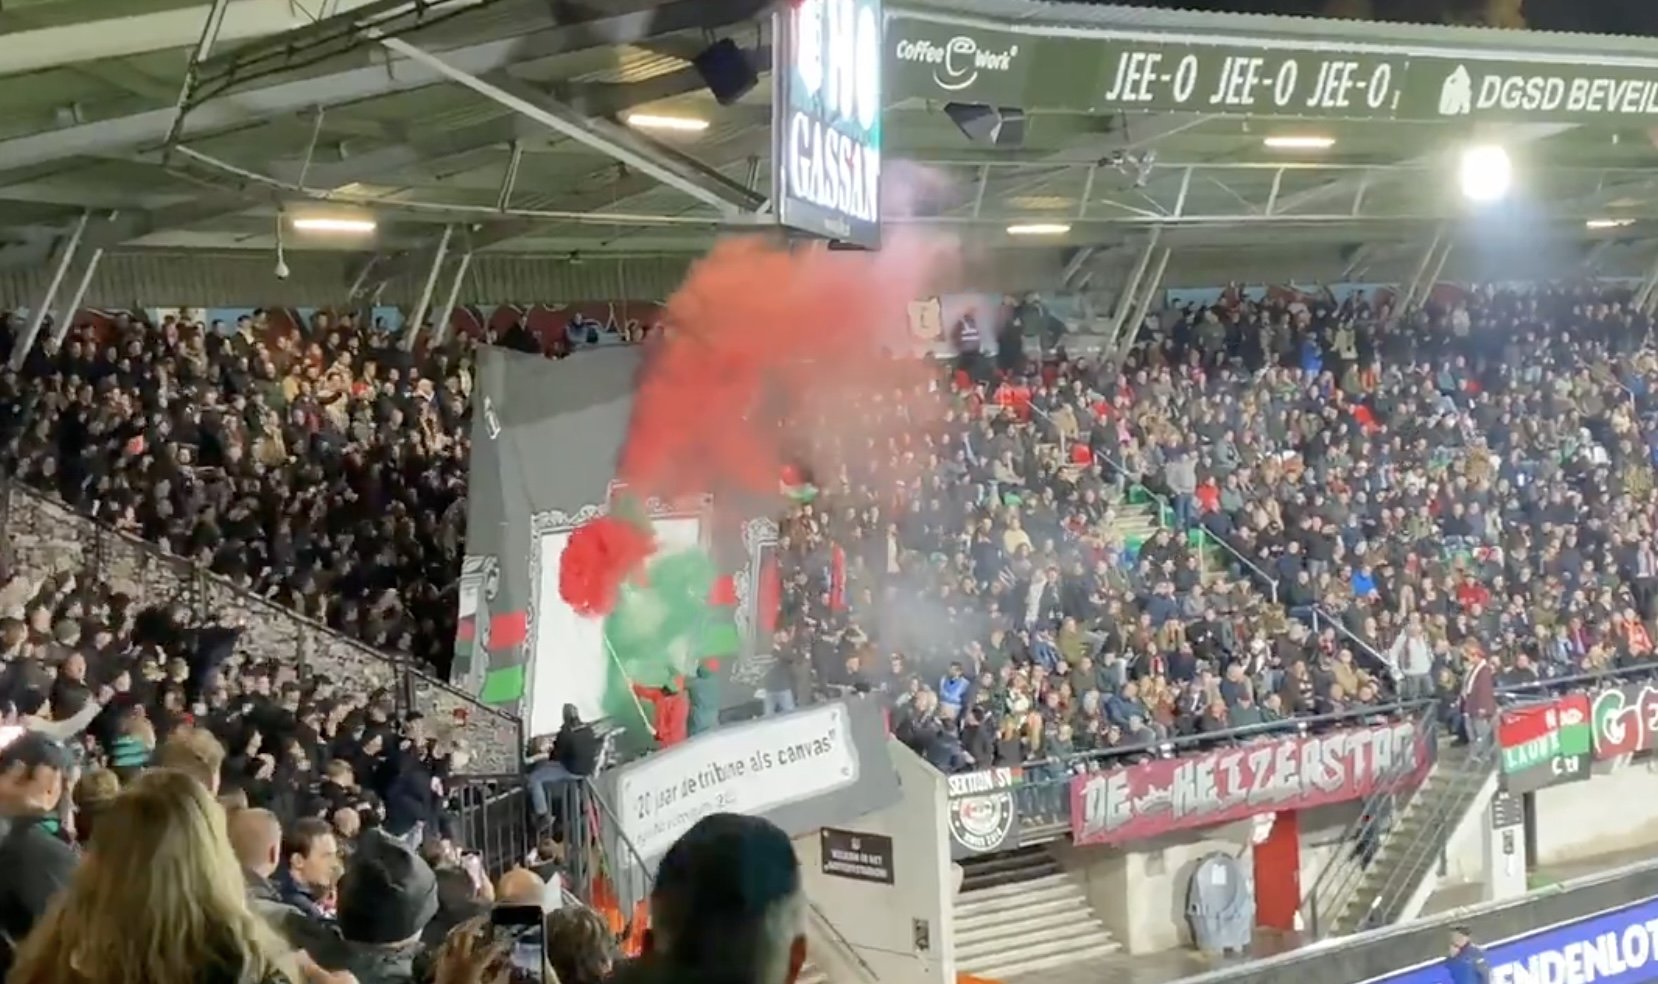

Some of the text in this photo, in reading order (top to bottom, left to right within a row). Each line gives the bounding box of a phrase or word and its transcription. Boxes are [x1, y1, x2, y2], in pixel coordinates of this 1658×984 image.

[896, 39, 945, 63] Coffee
[1476, 74, 1565, 111] DGSD
[790, 111, 879, 223] GASSAN
[681, 777, 698, 799] de
[750, 751, 773, 773] als
[1081, 771, 1131, 833] DE
